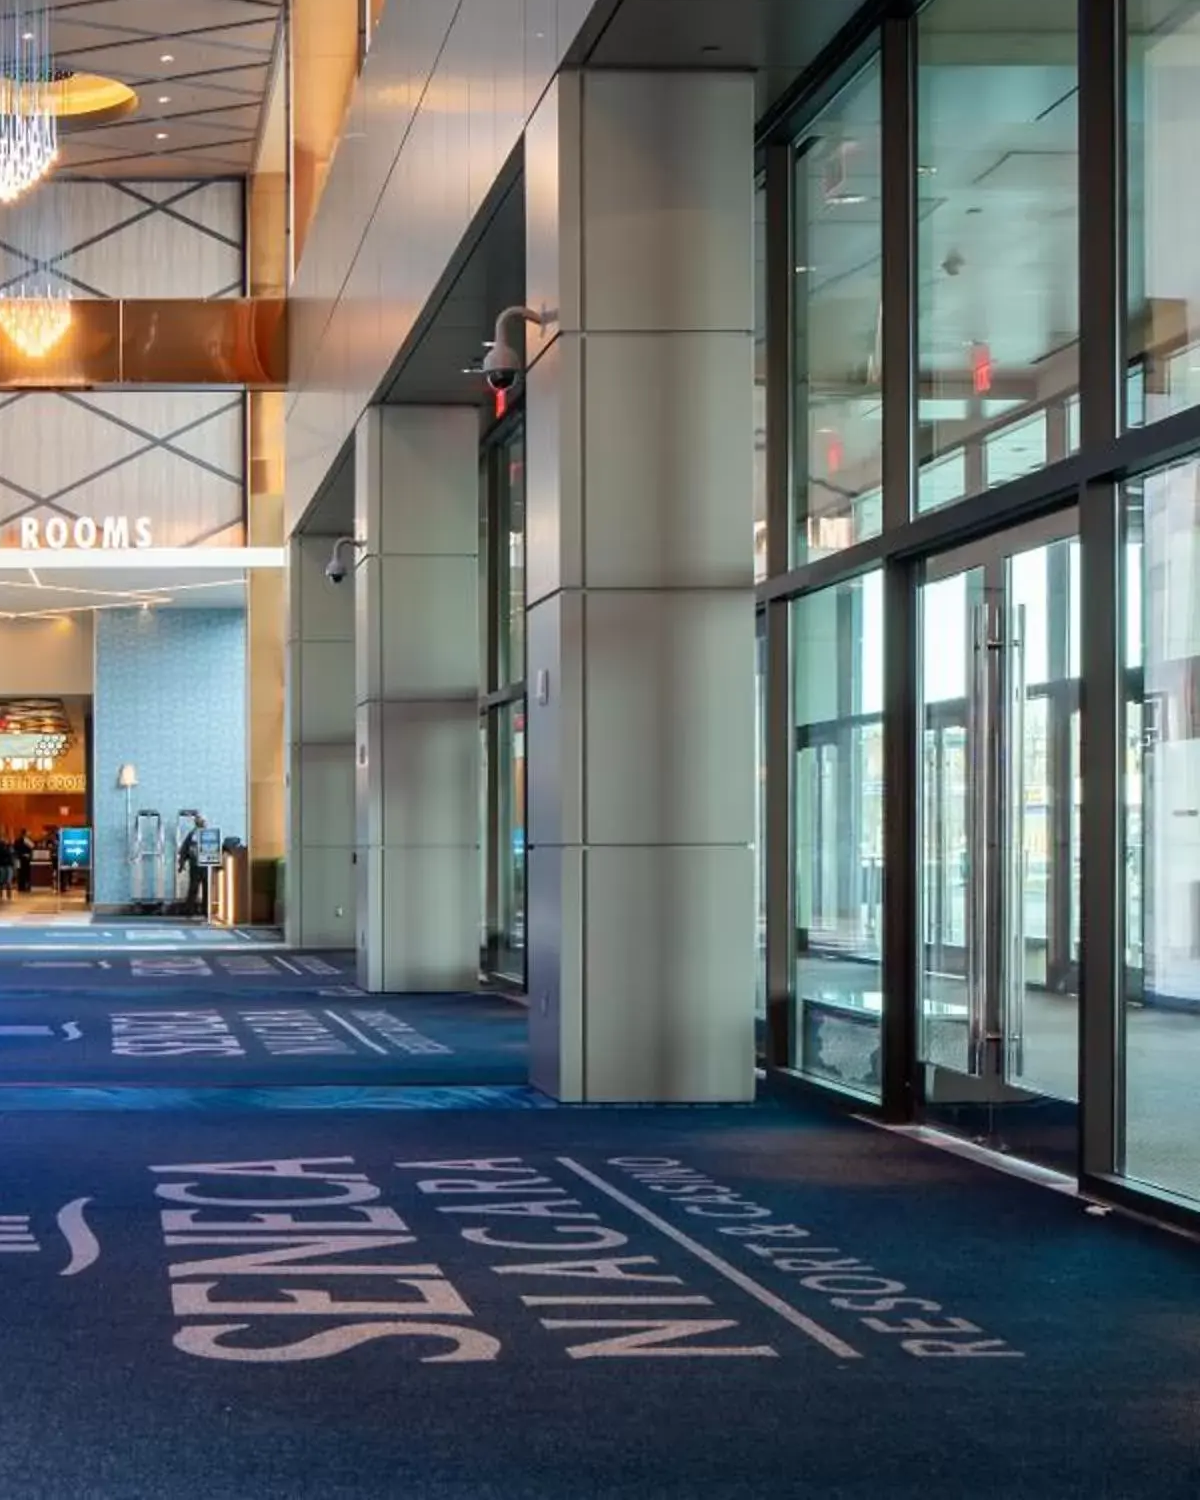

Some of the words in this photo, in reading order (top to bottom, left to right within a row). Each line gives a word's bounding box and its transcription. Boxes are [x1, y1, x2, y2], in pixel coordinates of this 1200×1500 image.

[19, 515, 153, 550] ROOMS
[606, 1155, 773, 1219] CASINO
[148, 1156, 502, 1364] SENECA
[394, 1156, 779, 1360] NIAGARA
[743, 1243, 1026, 1358] RESORT
